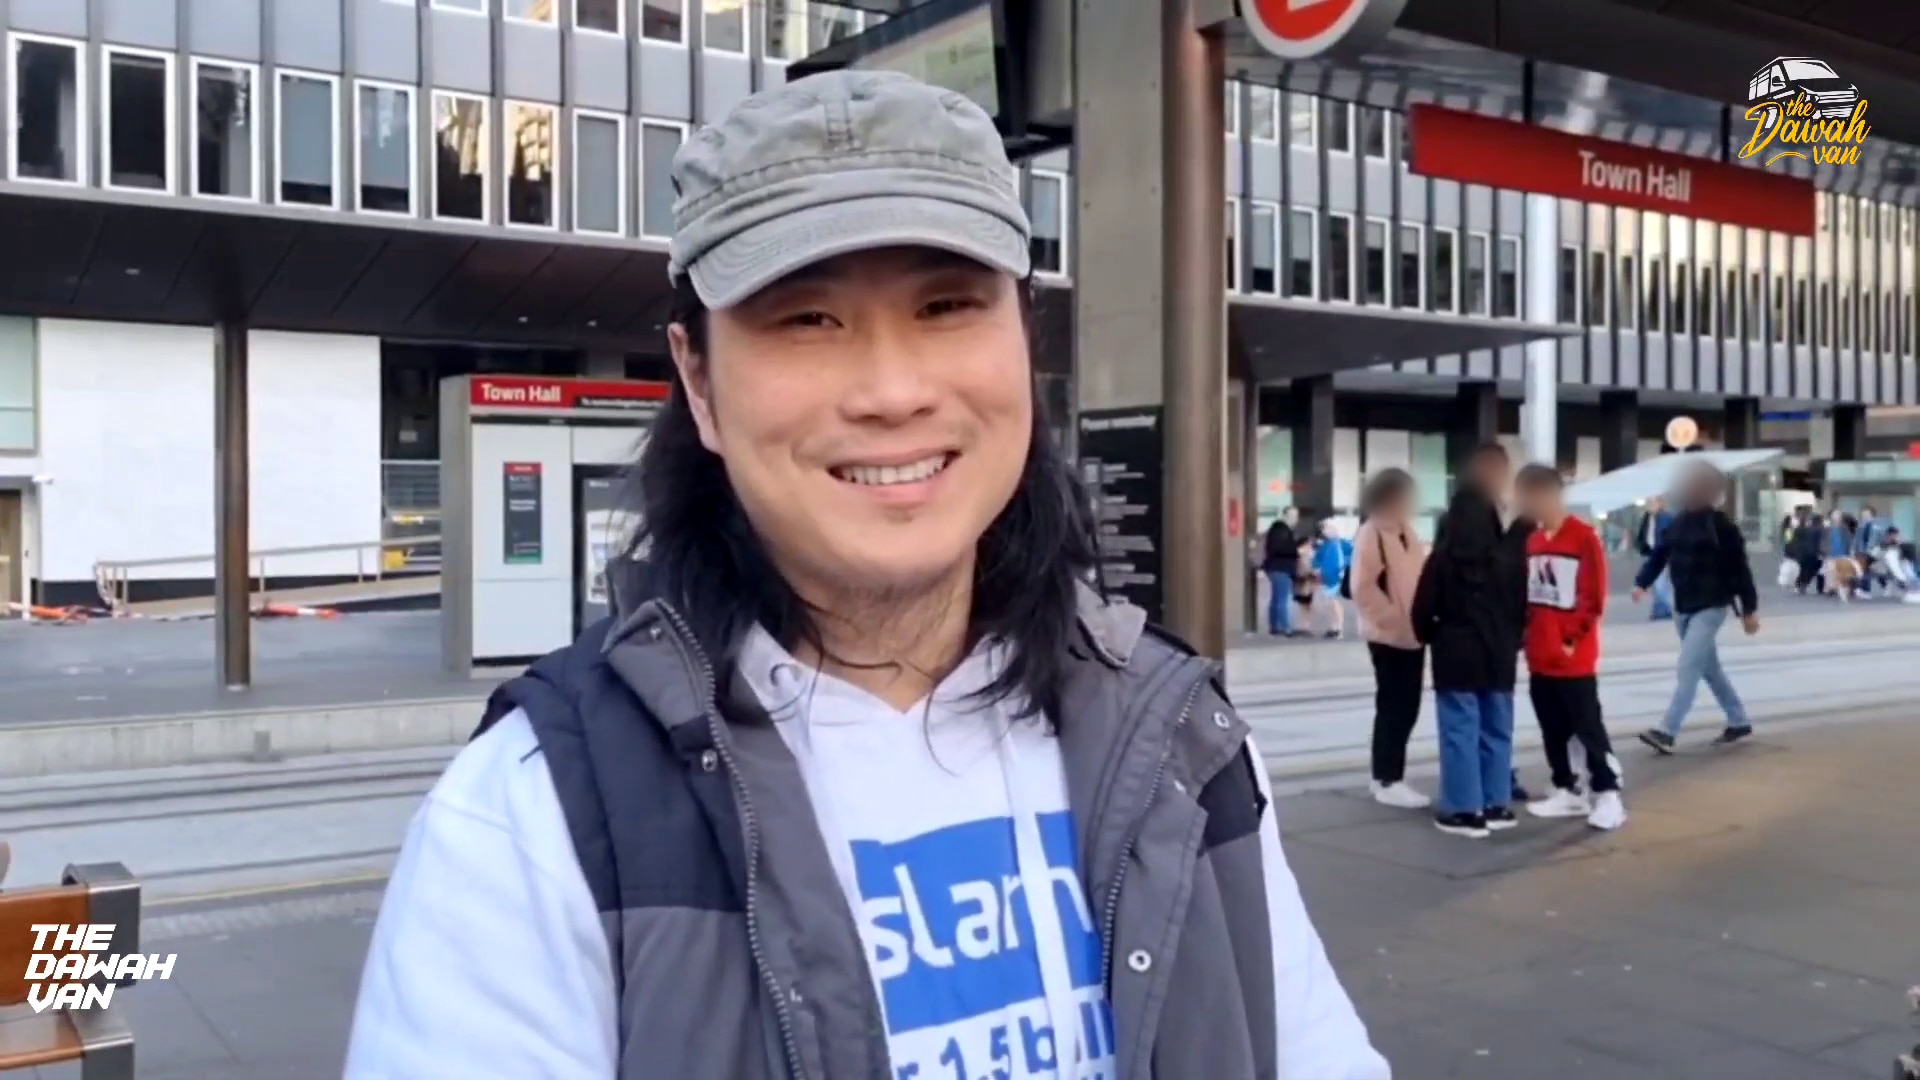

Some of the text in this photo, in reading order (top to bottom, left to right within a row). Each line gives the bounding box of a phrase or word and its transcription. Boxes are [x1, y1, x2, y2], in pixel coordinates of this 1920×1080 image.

[1579, 149, 1691, 203] Town Hall
[481, 382, 561, 402] Town Hall
[861, 863, 1094, 980] slam
